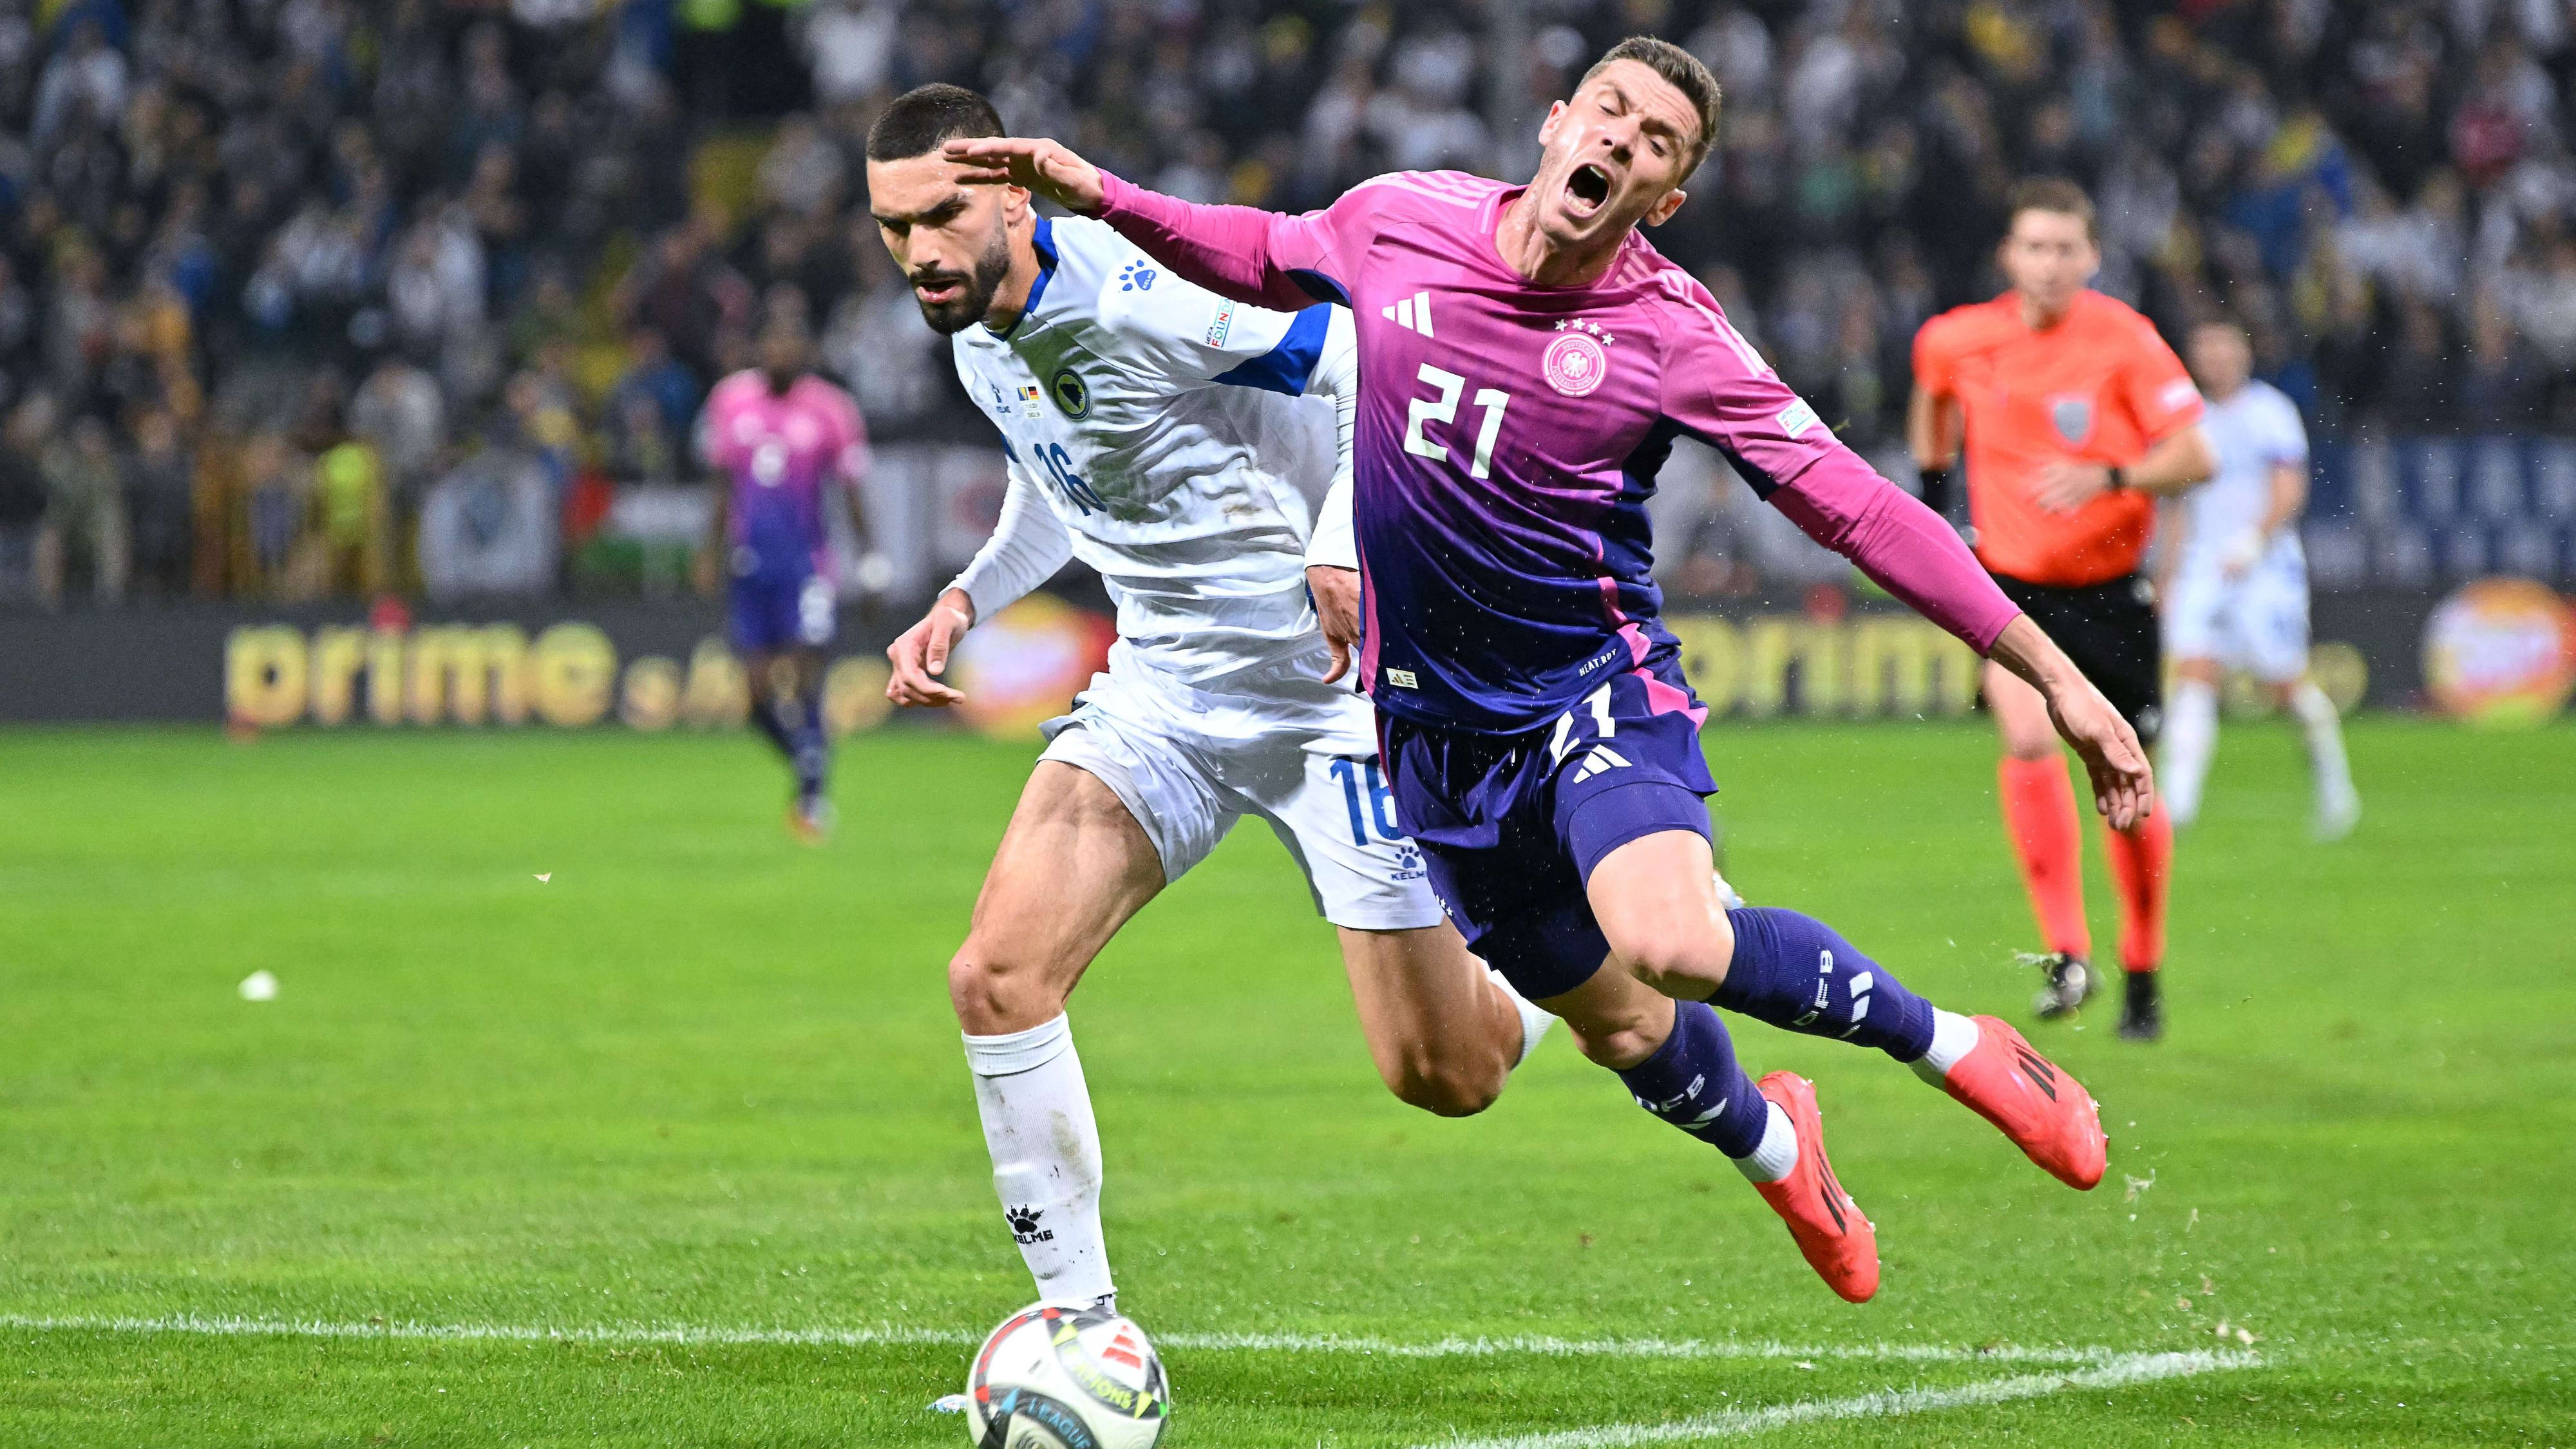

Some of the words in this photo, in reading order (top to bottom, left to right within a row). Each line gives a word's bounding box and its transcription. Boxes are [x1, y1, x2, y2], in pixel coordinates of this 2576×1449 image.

[1404, 363, 1511, 479] 21
[1034, 442, 1108, 516] 16
[225, 596, 616, 729] prime
[1578, 649, 1616, 676] HEAT.RDY
[1672, 585, 1982, 715] prim
[1330, 753, 1405, 847] 16
[1391, 871, 1427, 880] KELM
[1792, 950, 1833, 1026] DFB
[1012, 1229, 1054, 1244] KELME
